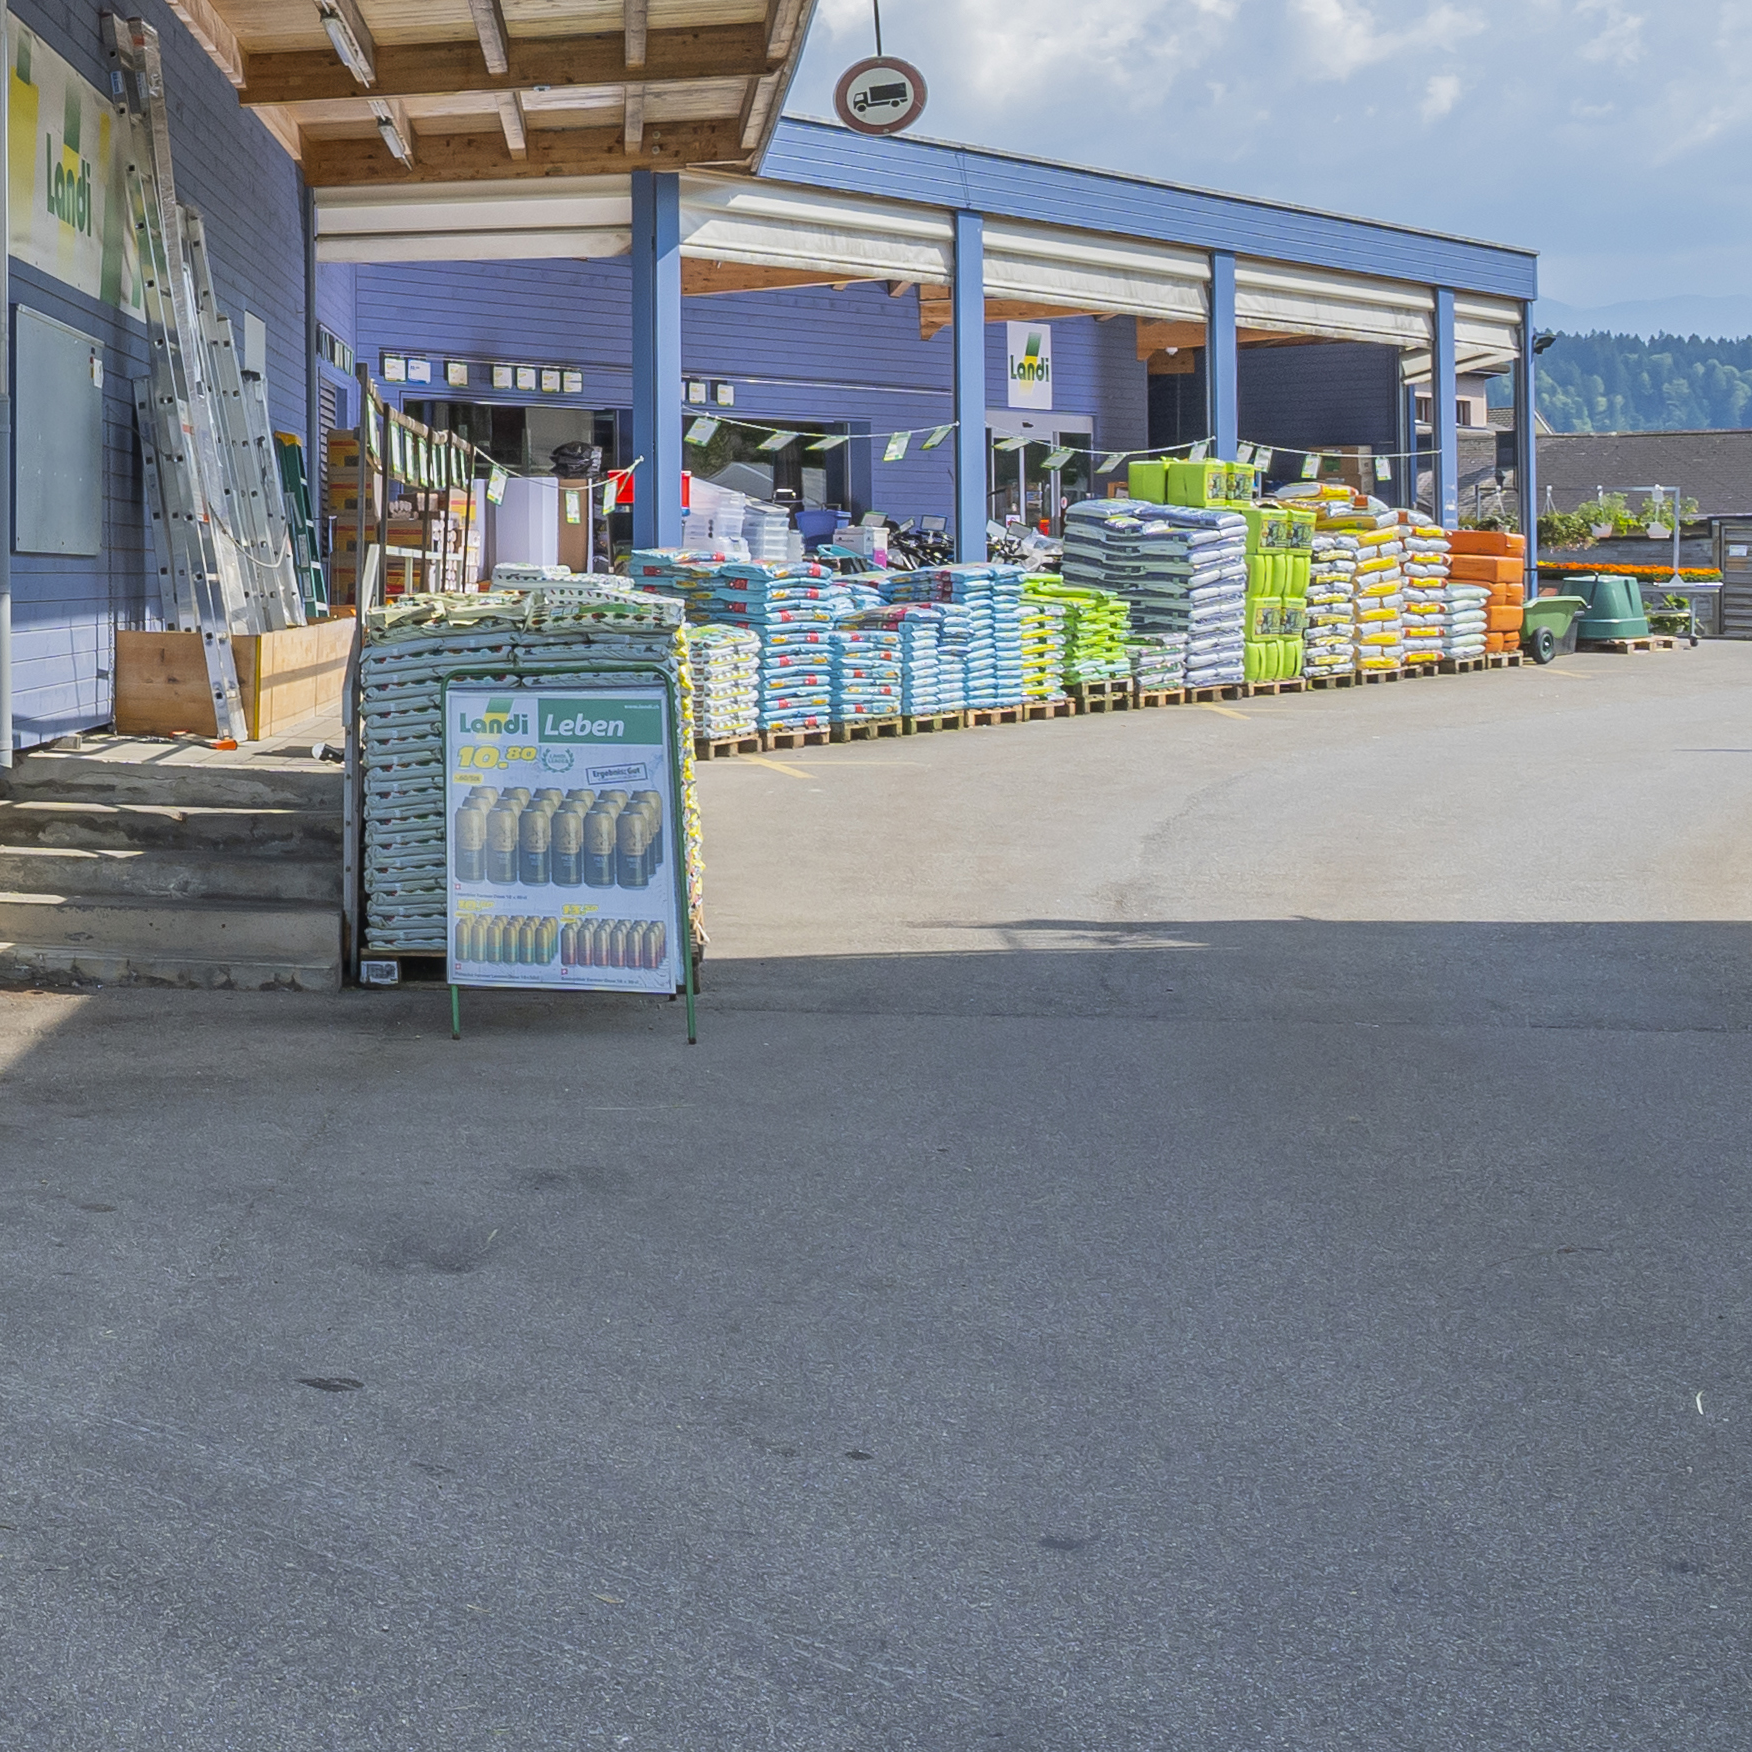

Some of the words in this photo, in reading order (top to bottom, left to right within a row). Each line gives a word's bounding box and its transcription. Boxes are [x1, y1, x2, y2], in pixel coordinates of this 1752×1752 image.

[46, 132, 92, 238] Landi
[1009, 354, 1050, 383] Landi
[460, 713, 528, 735] Landi
[545, 713, 625, 737] Leben
[458, 746, 538, 769] 10.80
